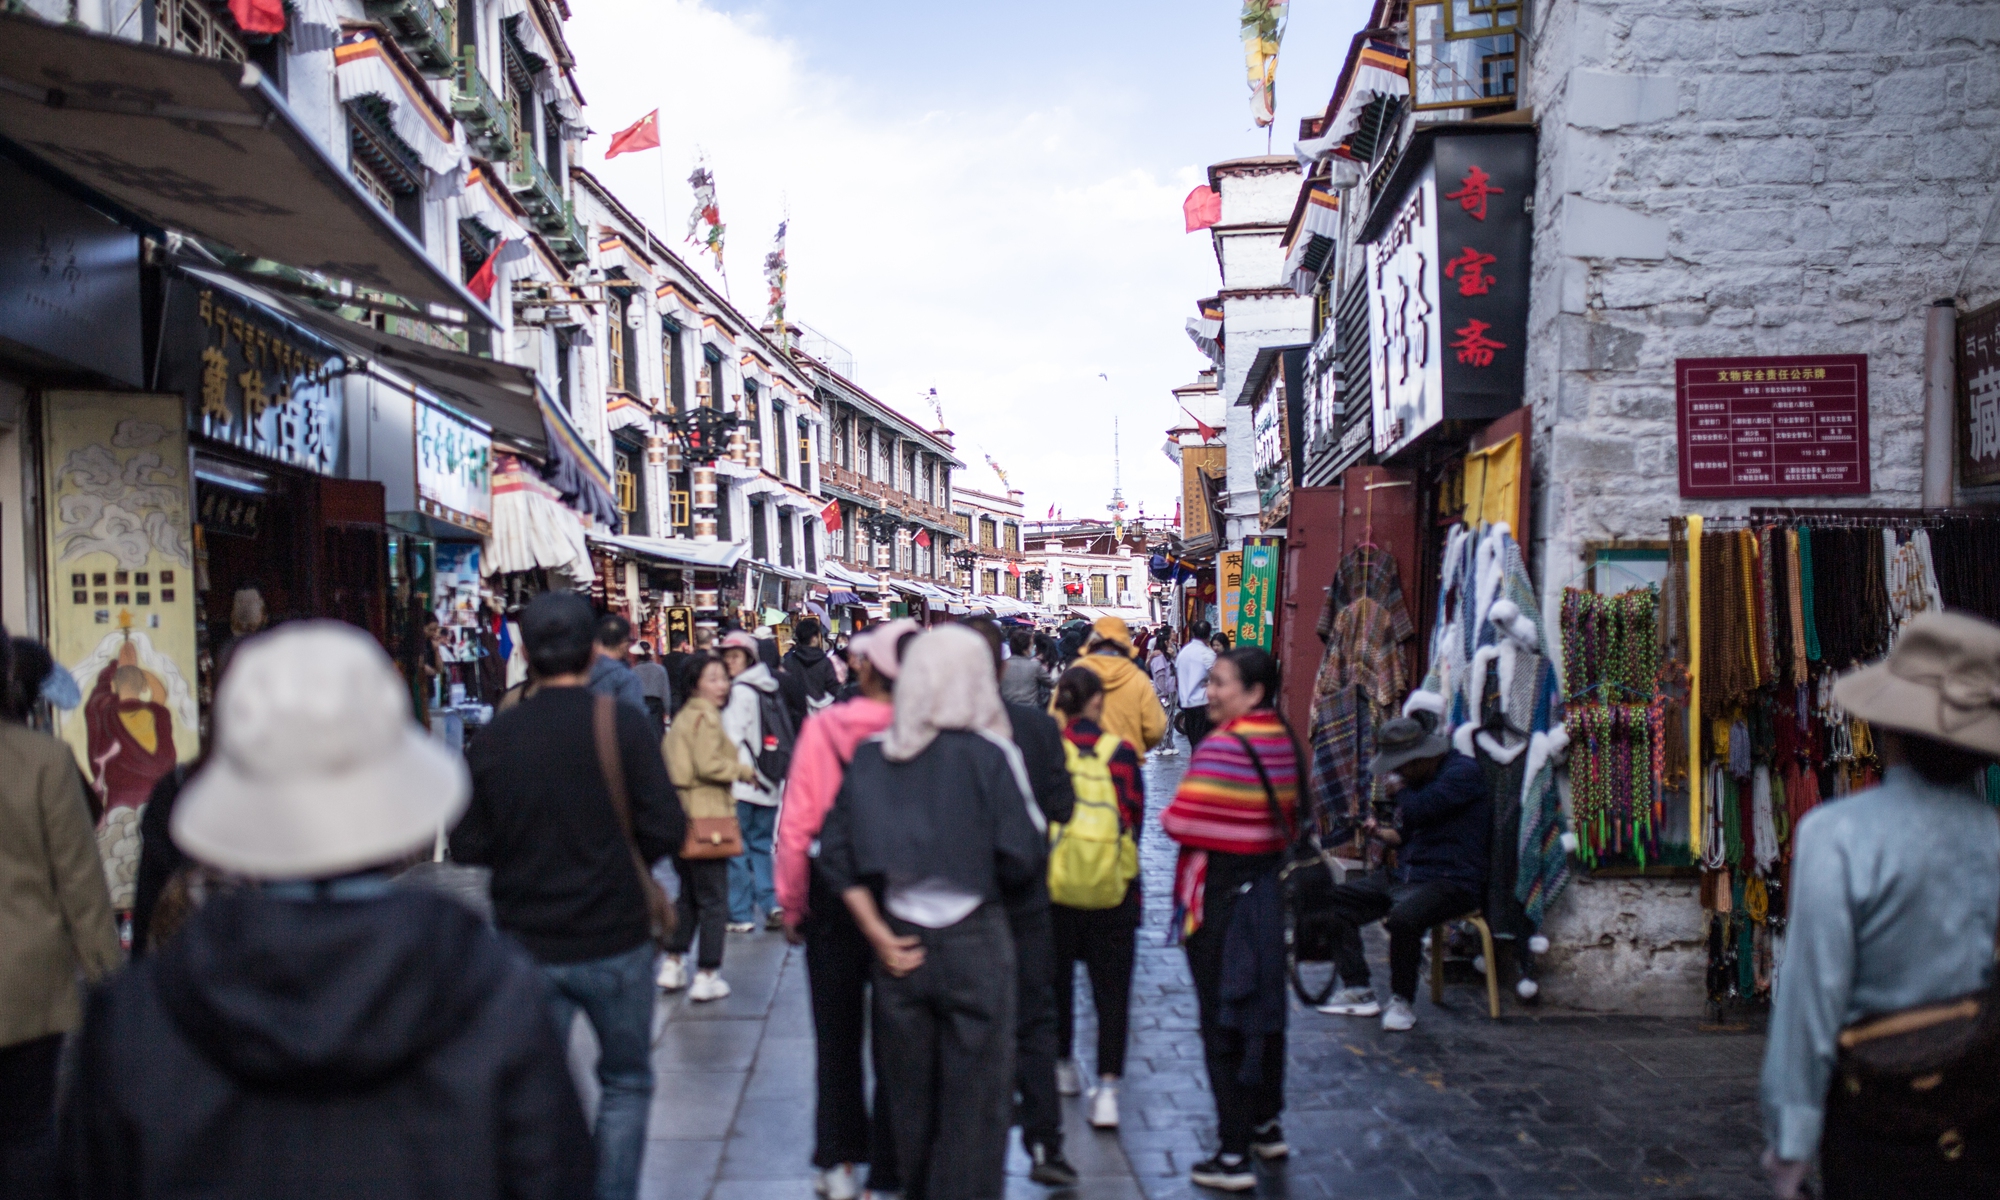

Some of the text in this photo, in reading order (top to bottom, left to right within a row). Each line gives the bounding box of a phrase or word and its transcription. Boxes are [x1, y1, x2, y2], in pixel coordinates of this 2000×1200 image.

[1445, 165, 1508, 368] 奇宝斋
[1718, 368, 1826, 382] 文物安全责任公示牌
